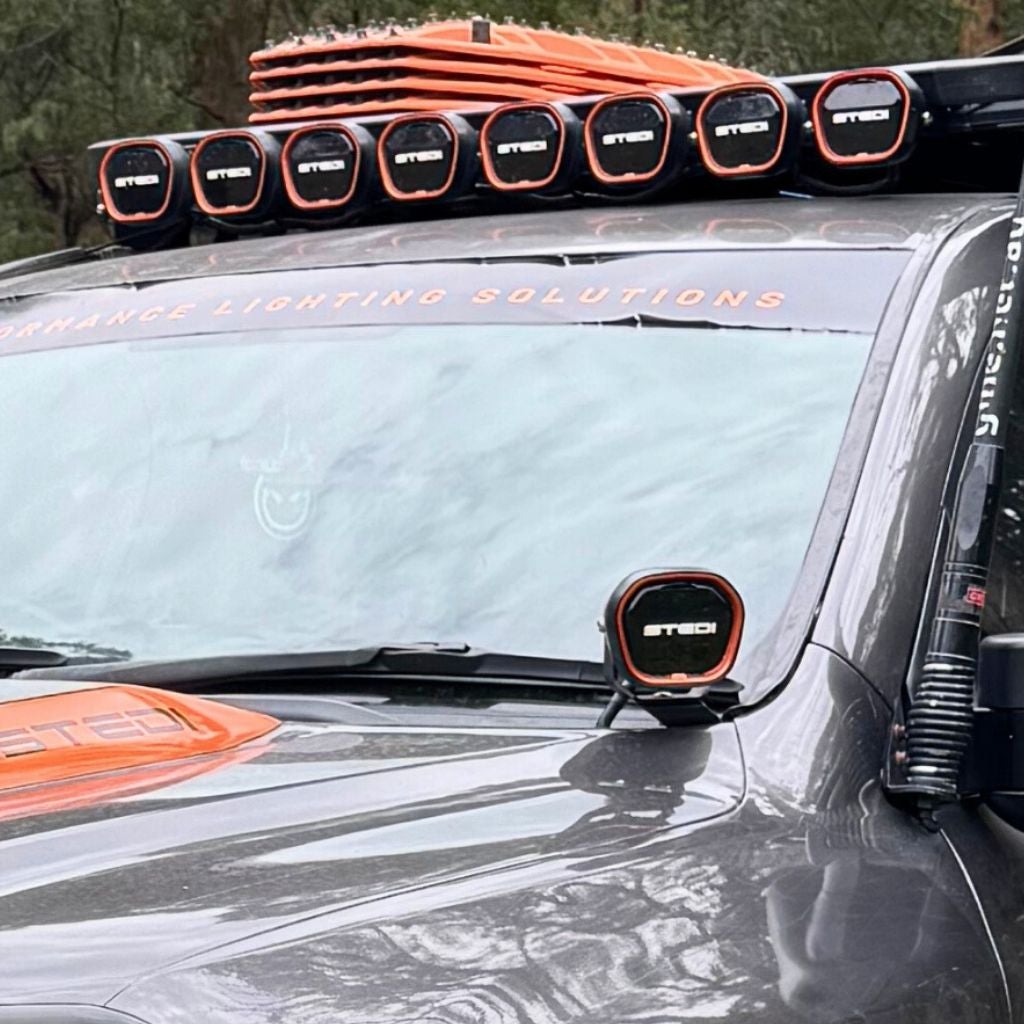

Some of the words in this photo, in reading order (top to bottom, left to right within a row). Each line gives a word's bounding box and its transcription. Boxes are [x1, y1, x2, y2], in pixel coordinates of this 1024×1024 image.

[832, 109, 889, 123] STEDI
[715, 121, 769, 136] STEDI
[213, 289, 446, 315] LIGHTING
[472, 287, 786, 308] SOLUTIONS
[643, 622, 717, 636] STEDI
